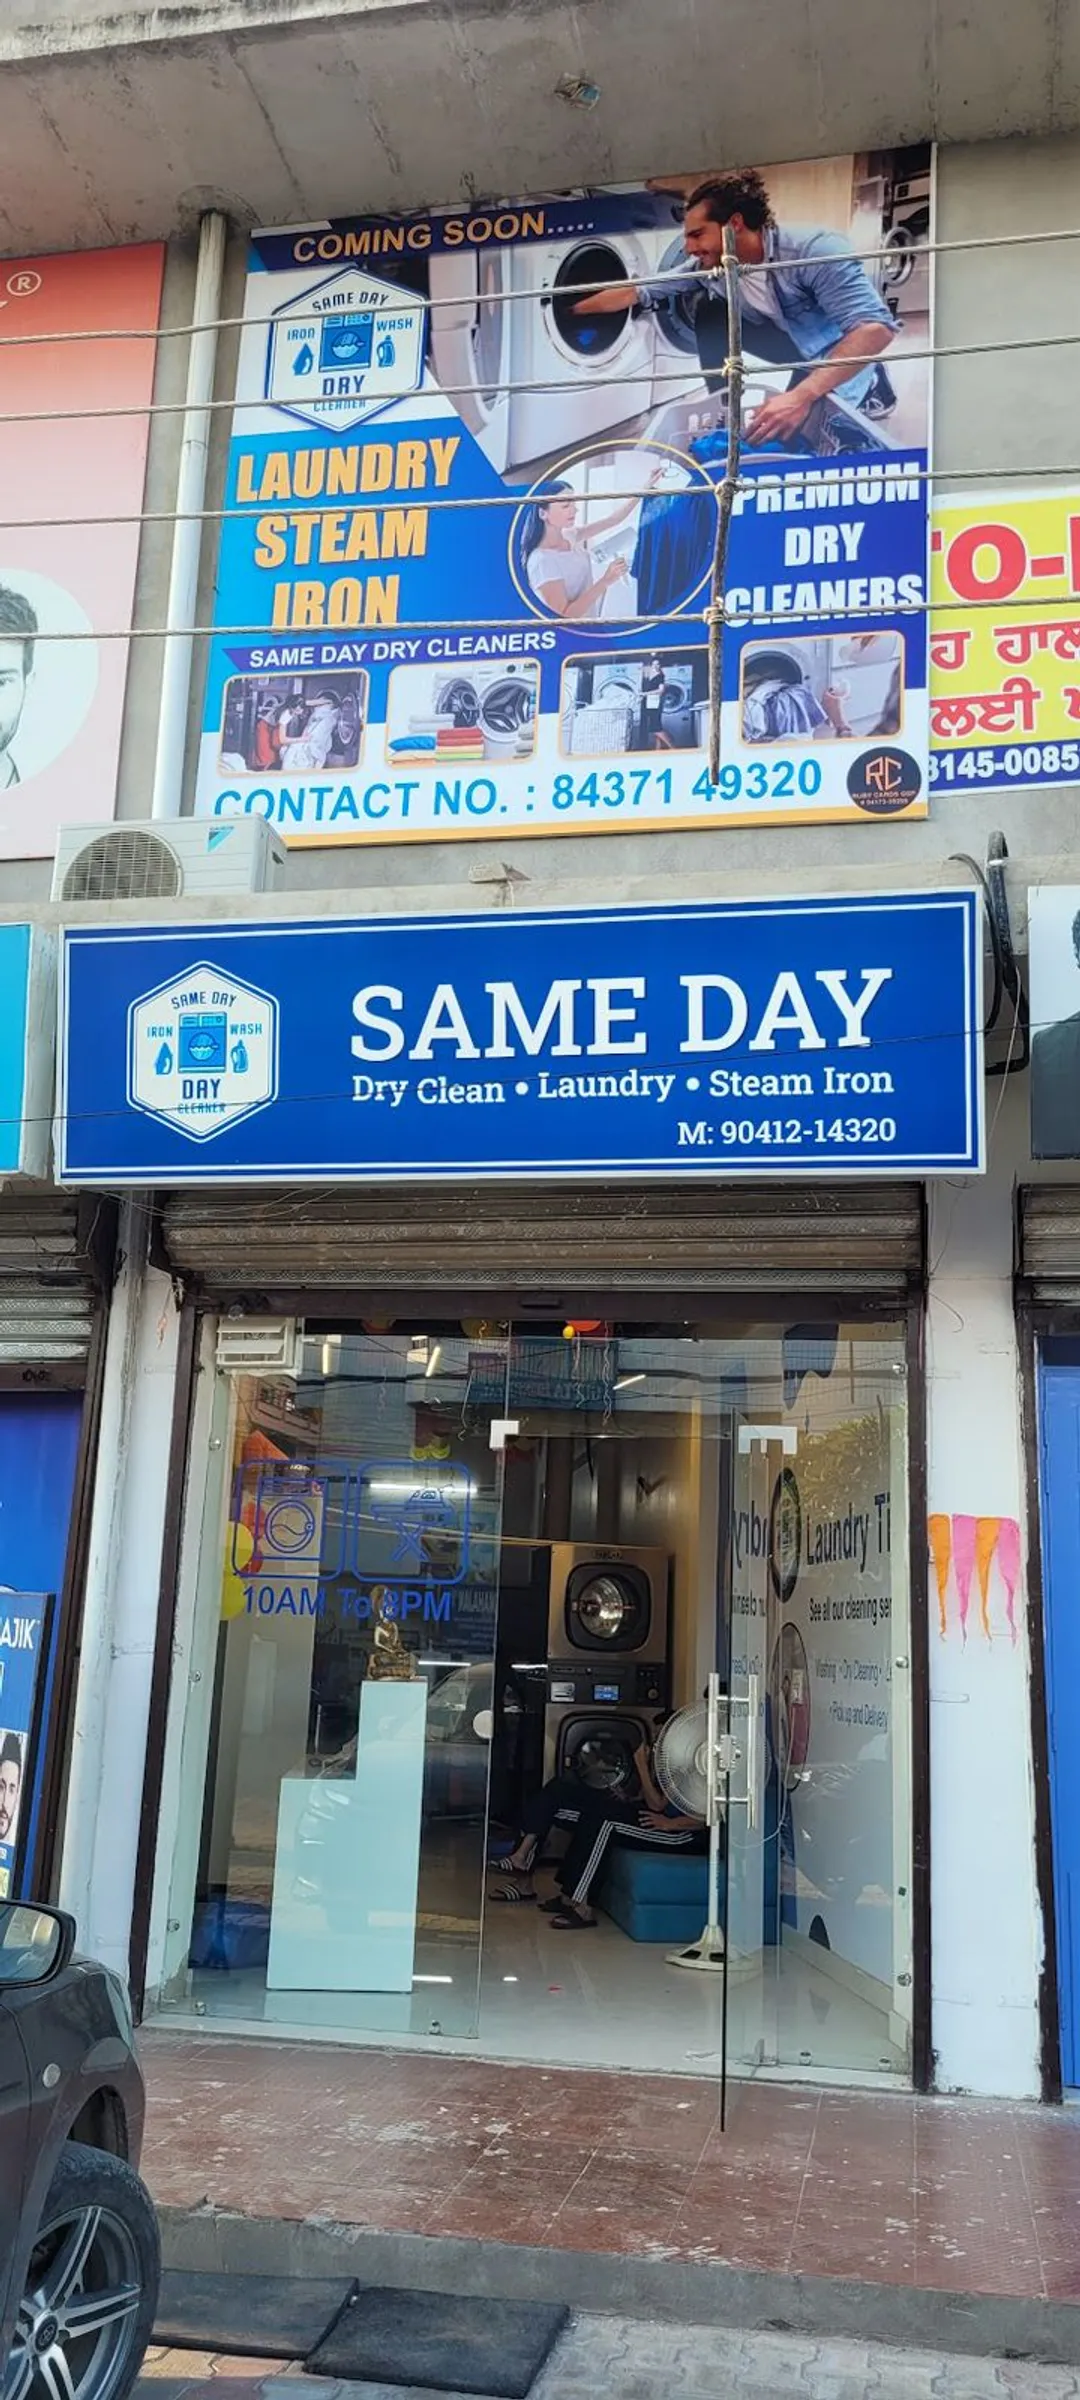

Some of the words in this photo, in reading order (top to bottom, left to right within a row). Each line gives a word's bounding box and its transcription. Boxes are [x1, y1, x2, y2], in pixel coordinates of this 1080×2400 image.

[293, 225, 432, 263] COMING
[312, 292, 354, 312] SAME
[359, 291, 389, 306] DAY
[287, 327, 315, 341] IRON
[376, 318, 413, 332] WASH
[322, 374, 366, 396] DRY
[236, 436, 461, 504] LAUNDRY
[731, 461, 920, 517] PREMIUM
[254, 508, 429, 568] STEAM
[784, 522, 866, 567] DRY
[271, 574, 400, 630] IRON
[723, 573, 924, 628] CLEANERS
[249, 648, 314, 669] SAME
[321, 644, 369, 664] DAY
[375, 639, 422, 662] DRY
[426, 631, 557, 657] CLEANERS
[214, 781, 420, 823] CONTACT
[433, 778, 507, 816] NO.
[551, 770, 673, 810] 84371
[692, 758, 822, 802] 49320
[171, 991, 207, 1010] SAME
[211, 991, 237, 1008] DAY
[351, 976, 647, 1063] SAME
[679, 967, 893, 1053] DAY
[147, 1025, 173, 1039] IRON
[230, 1023, 263, 1036] WASH
[352, 1075, 408, 1107] Dry
[417, 1076, 505, 1105] Clean
[537, 1069, 677, 1102] Laundry
[709, 1068, 814, 1097] Steam
[823, 1066, 894, 1095] Iron
[677, 1120, 714, 1145] M:
[721, 1117, 897, 1145] 90412-14320
[806, 1502, 869, 1573] Laundry
[243, 1585, 326, 1617] 10AM
[337, 1587, 371, 1618] To
[383, 1589, 451, 1622] 8PM
[809, 1598, 821, 1621] See
[833, 1600, 844, 1620] our
[846, 1593, 877, 1626] cleaning
